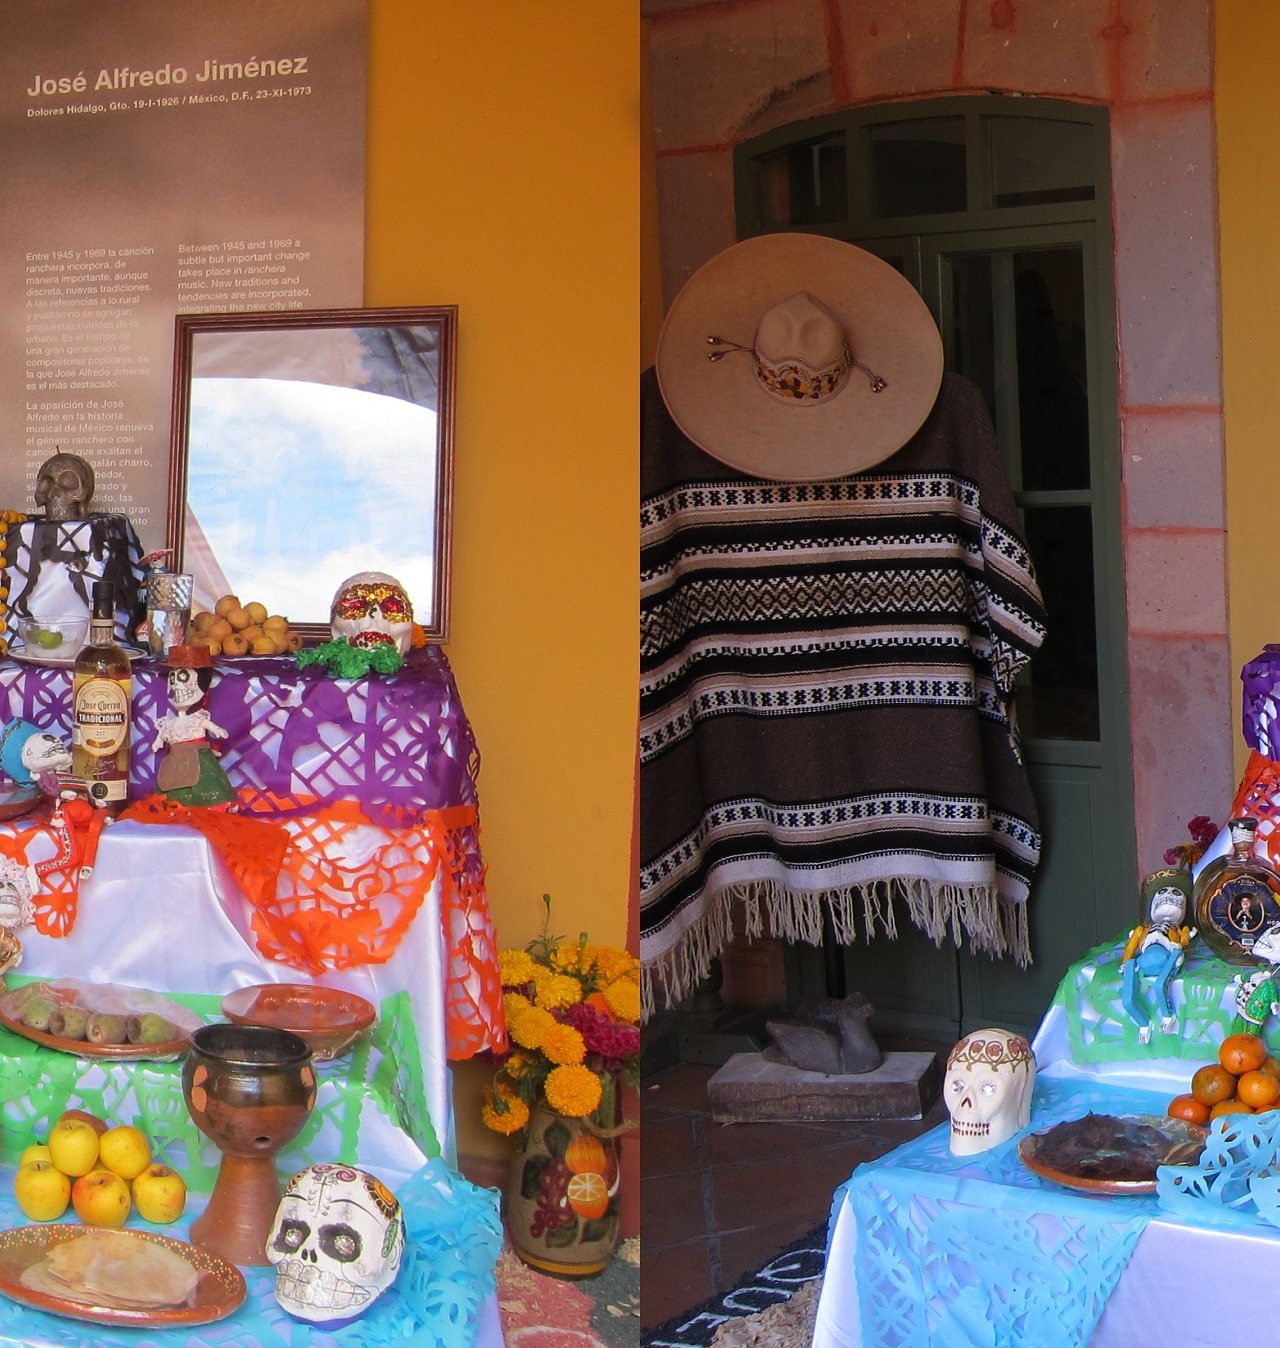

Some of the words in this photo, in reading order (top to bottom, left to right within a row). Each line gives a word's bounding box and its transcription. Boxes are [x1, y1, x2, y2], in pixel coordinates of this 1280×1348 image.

[27, 71, 87, 97] José
[94, 64, 187, 91] Alfredo
[196, 56, 309, 83] Jiménez
[27, 107, 64, 117] Dolores
[67, 103, 107, 115] Hidalgo,
[110, 101, 130, 111] Gto.
[133, 97, 179, 109] 19-I-1926
[189, 94, 229, 104] México,
[232, 92, 253, 102] D.F.,
[256, 86, 312, 99] 23-XI-1973
[178, 244, 219, 253] Between
[222, 242, 244, 251] 1945
[248, 241, 265, 249] and
[269, 239, 292, 248] 1969
[26, 252, 49, 261] Entre
[52, 251, 73, 260] 1945
[76, 252, 81, 261] y
[84, 249, 106, 258] 1969
[109, 248, 116, 256] la
[119, 246, 154, 256] canción
[178, 256, 206, 265] subtle
[209, 255, 224, 264] but
[227, 253, 272, 264] important
[275, 252, 310, 262] change
[26, 264, 64, 273] ranchera
[67, 262, 112, 272] incorpora,
[178, 268, 202, 277] takes
[206, 268, 231, 277] place
[234, 266, 242, 274] in
[244, 265, 286, 274] ranchera
[26, 276, 58, 284] manera
[62, 274, 112, 284] importante,
[115, 272, 148, 282] aunque
[178, 281, 208, 289] music.
[211, 280, 232, 288] New
[235, 277, 278, 286] traditions
[281, 276, 300, 285] and
[26, 288, 63, 297] discreta,
[66, 286, 98, 294] nuevas
[100, 284, 152, 294] tradiciones.
[178, 292, 228, 301] tendencies
[231, 291, 245, 299] are
[248, 288, 311, 299] incorporated,
[178, 303, 226, 313] integrating
[230, 303, 244, 312] the
[246, 303, 266, 311] new
[269, 302, 286, 311] city
[289, 300, 302, 309] life
[26, 402, 37, 410] La
[40, 400, 84, 411] aparición
[87, 401, 98, 409] de
[101, 400, 124, 408] José
[79, 714, 122, 723] TRADICIONAL
